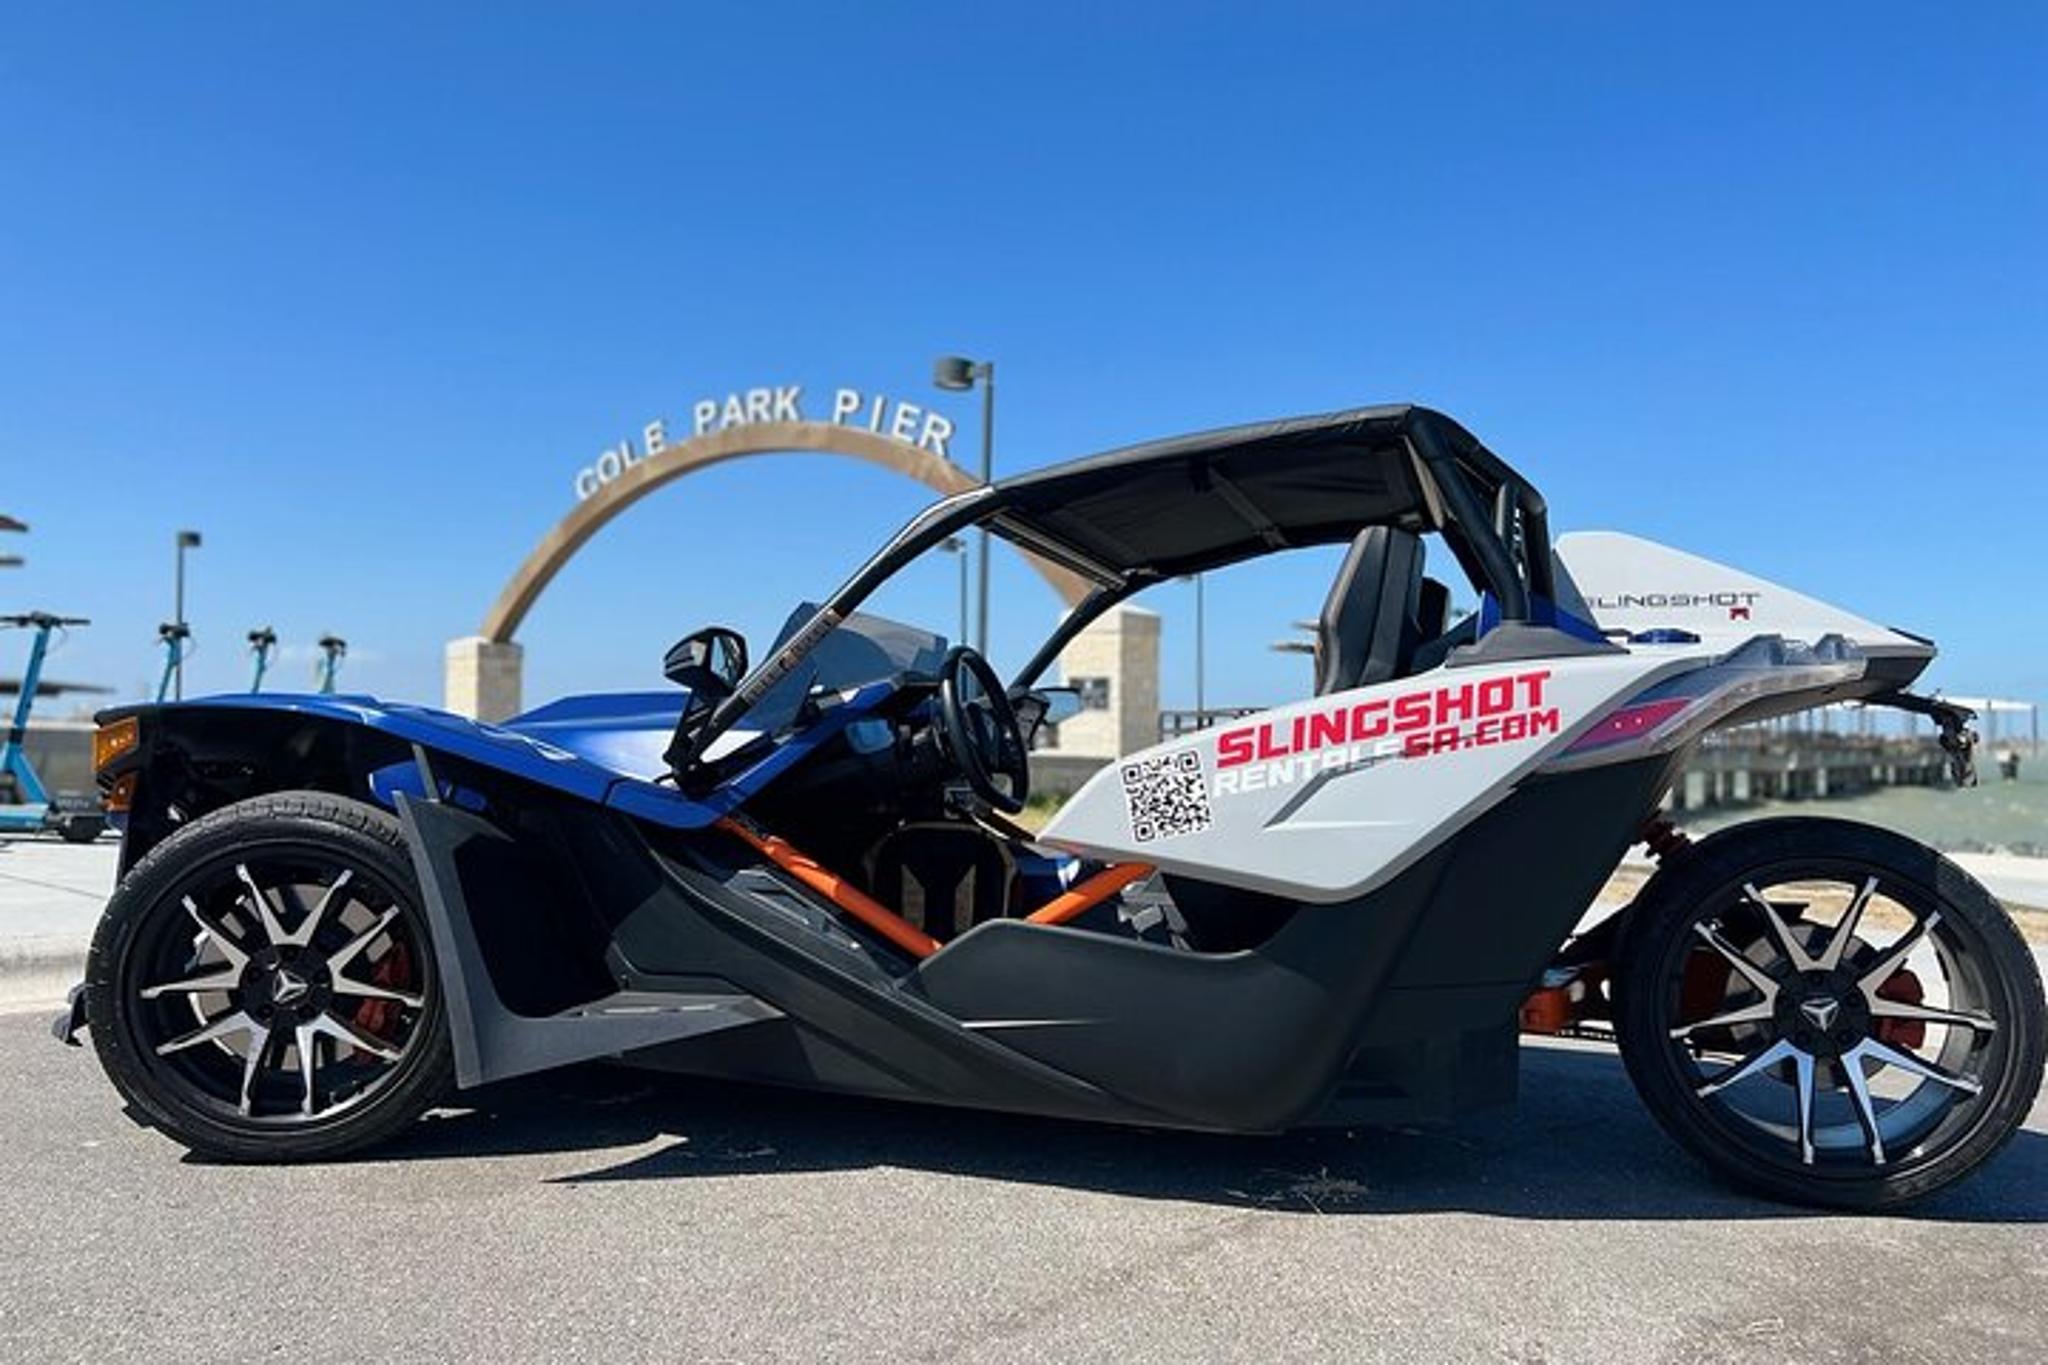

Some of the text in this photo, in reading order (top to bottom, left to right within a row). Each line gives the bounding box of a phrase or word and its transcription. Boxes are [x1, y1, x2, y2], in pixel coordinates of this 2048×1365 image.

[576, 387, 954, 500] COLE PARK PIER
[1217, 671, 1551, 768] SLINGSHOT
